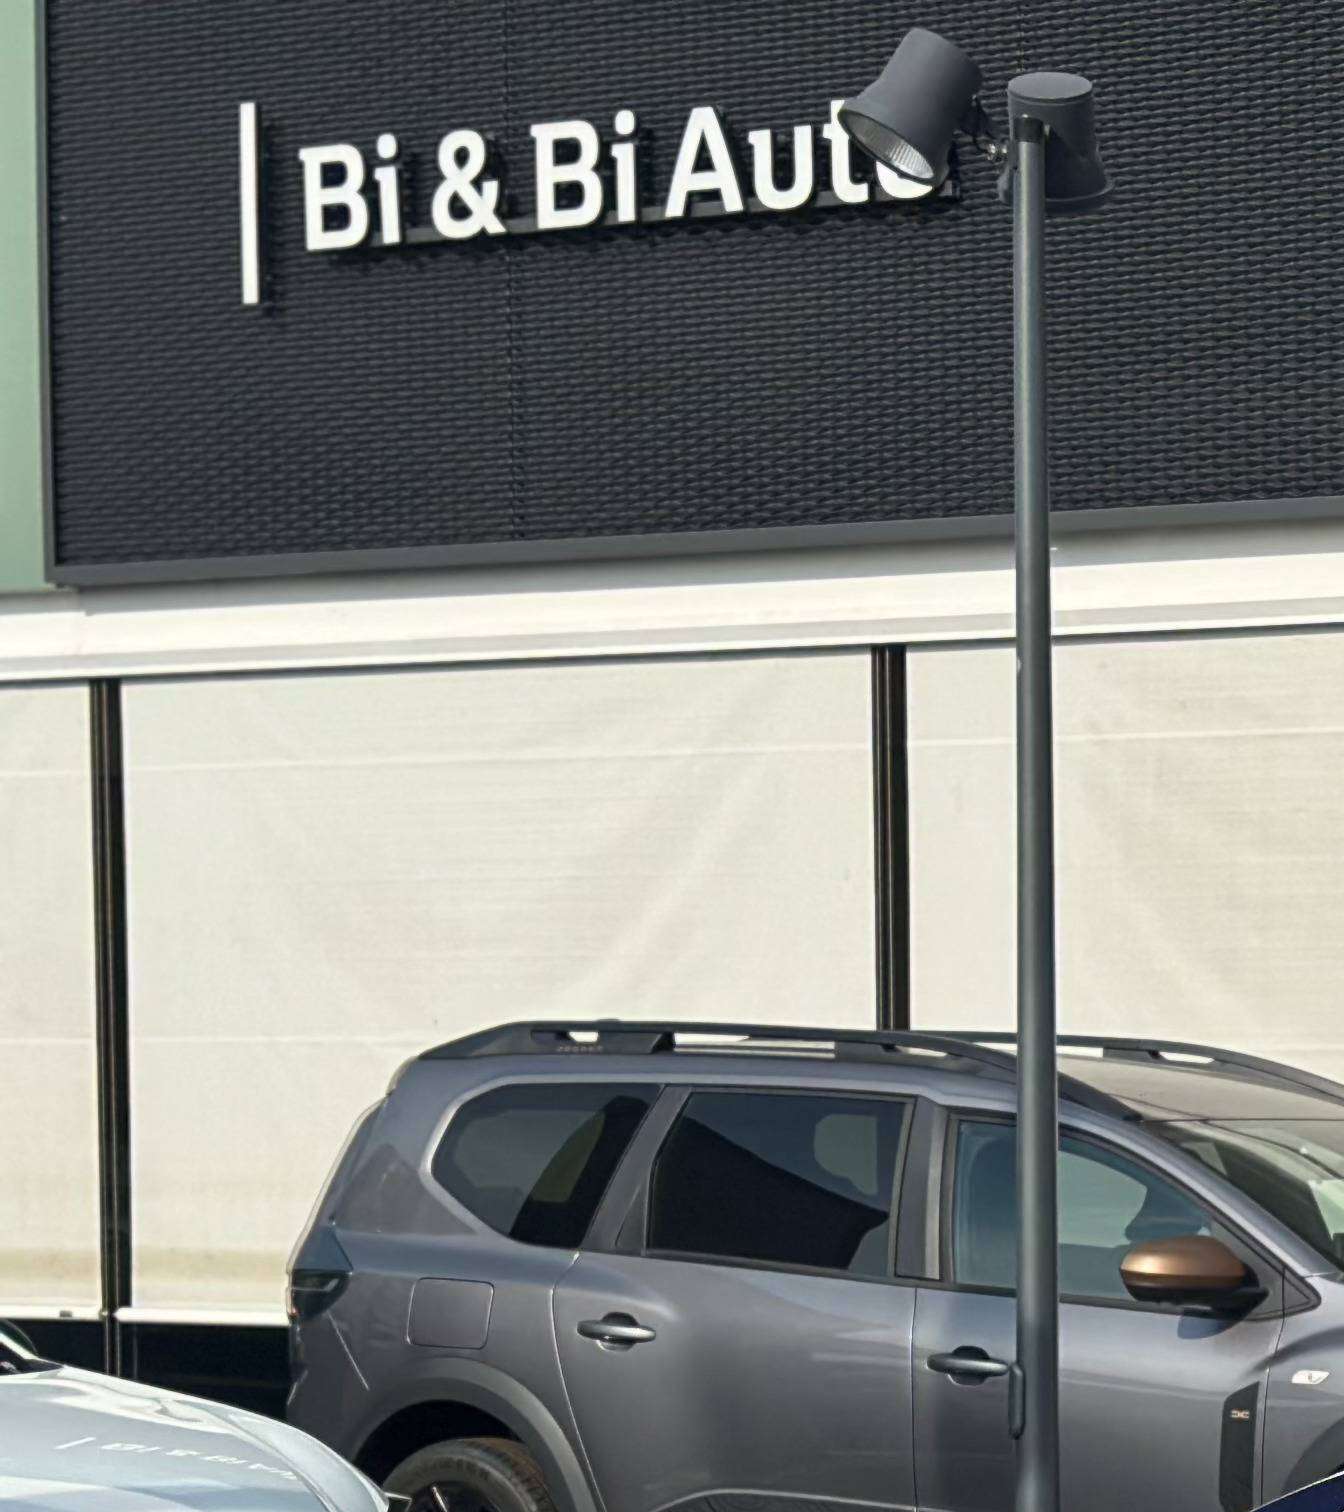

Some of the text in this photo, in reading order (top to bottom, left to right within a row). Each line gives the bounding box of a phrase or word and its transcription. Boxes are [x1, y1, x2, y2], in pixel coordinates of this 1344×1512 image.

[299, 132, 400, 252] Bi
[430, 129, 506, 241] &
[530, 109, 636, 230] Bi
